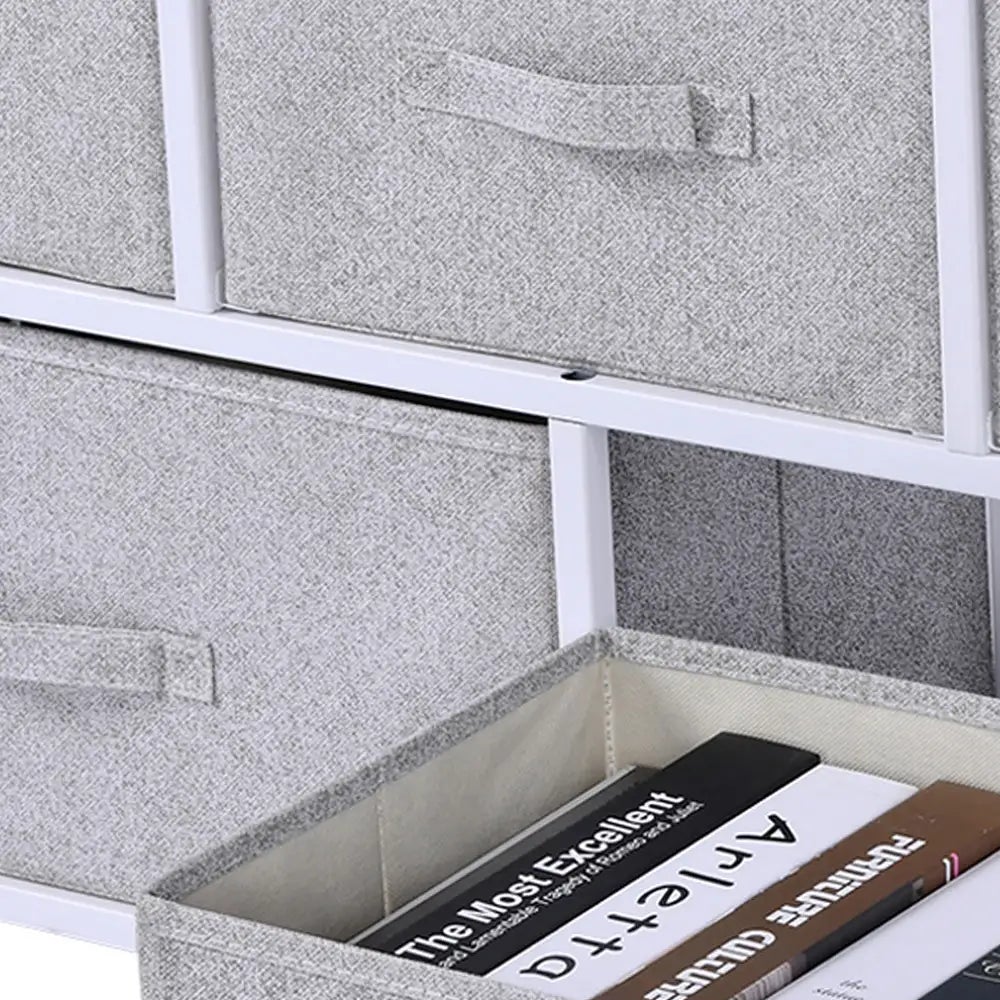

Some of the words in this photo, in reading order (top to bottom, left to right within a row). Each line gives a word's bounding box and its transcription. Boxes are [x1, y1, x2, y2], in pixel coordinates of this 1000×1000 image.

[395, 923, 473, 959] The
[457, 874, 552, 923] Most
[533, 792, 684, 875] Excellent
[519, 813, 797, 980] Arletta
[530, 873, 592, 905] Tragedy
[585, 862, 603, 875] of
[595, 837, 647, 866] Romeo
[643, 821, 672, 839] and
[765, 834, 927, 928] FURNITURE
